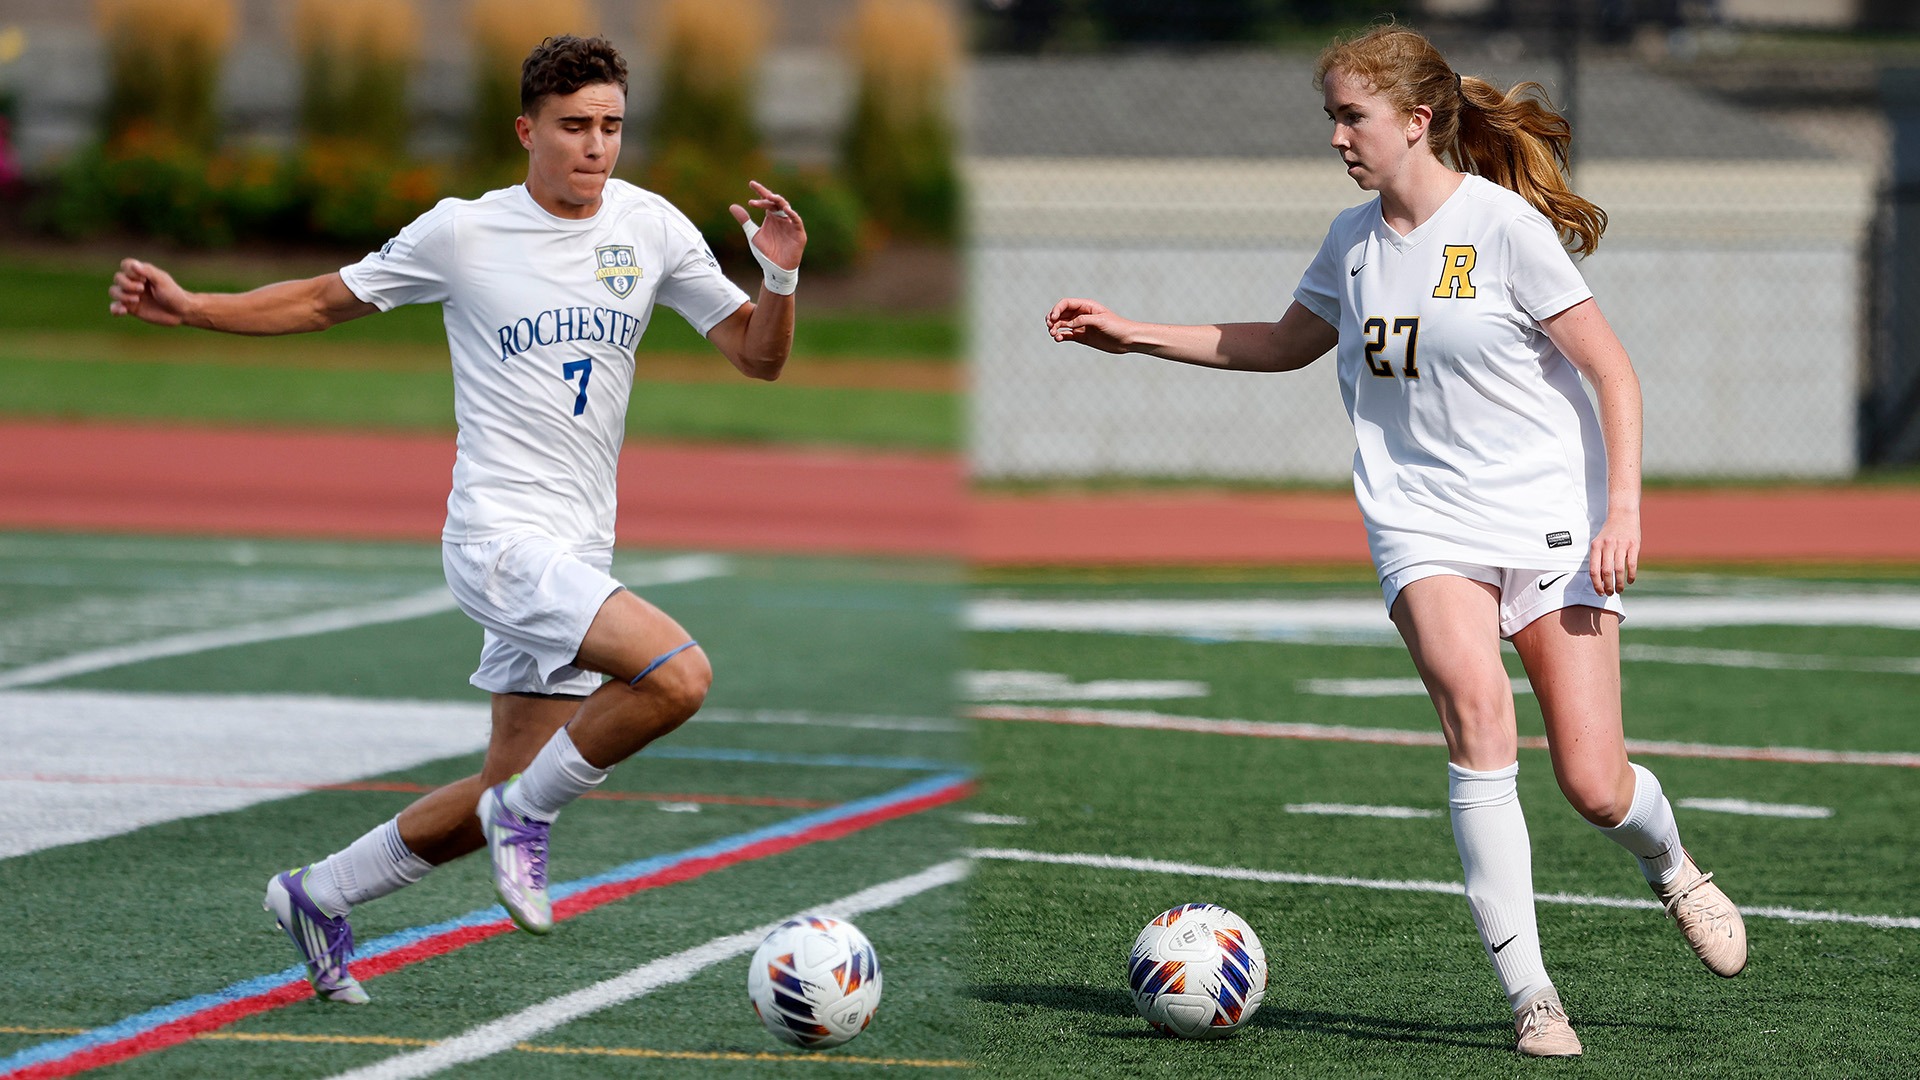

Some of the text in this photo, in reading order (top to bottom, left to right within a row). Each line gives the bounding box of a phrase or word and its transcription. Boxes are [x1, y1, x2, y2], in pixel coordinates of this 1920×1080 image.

[600, 267, 638, 277] MELIORA
[1432, 245, 1477, 299] R
[1363, 316, 1420, 379] 27
[562, 358, 593, 417] 7
